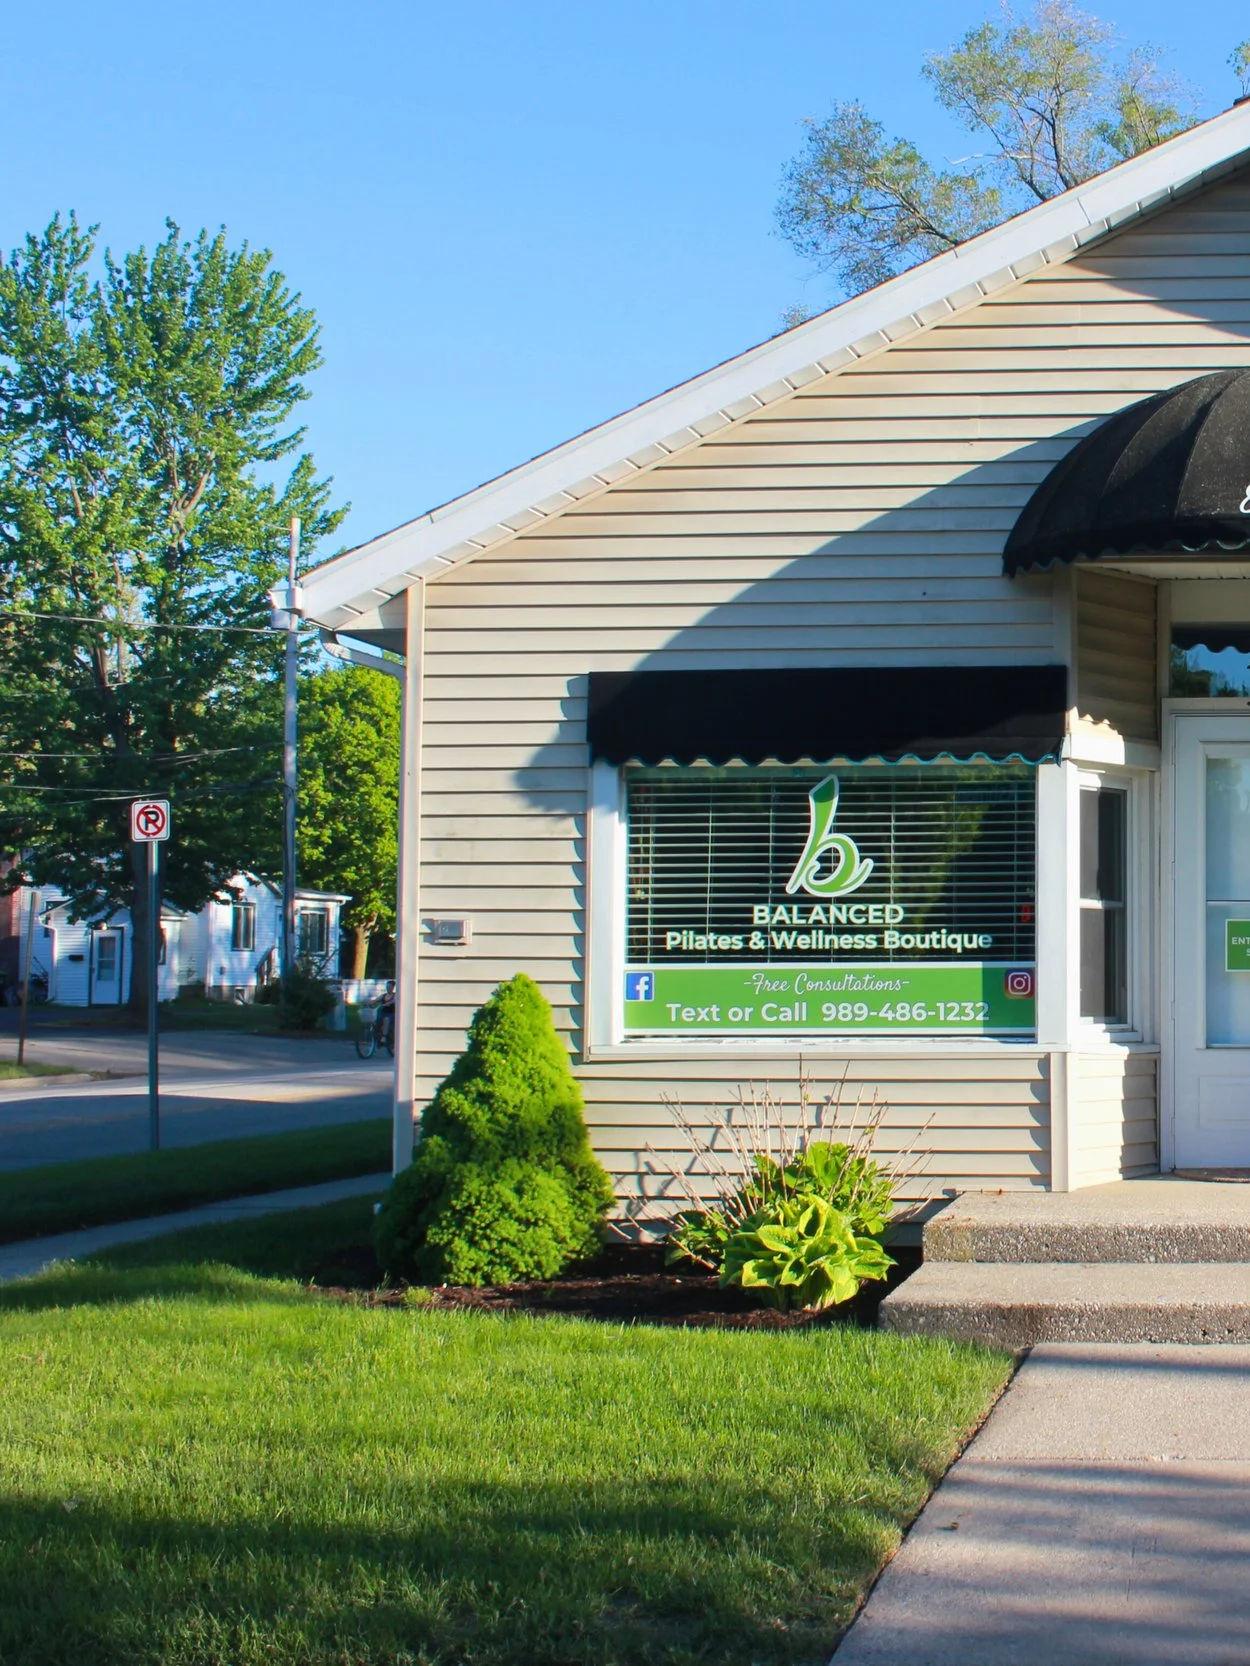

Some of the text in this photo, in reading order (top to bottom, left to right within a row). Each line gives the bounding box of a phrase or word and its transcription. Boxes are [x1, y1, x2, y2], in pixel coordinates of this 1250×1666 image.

[753, 904, 905, 925] BALANCED
[666, 928, 993, 954] Pilates & Wellness Boutique
[666, 1002, 990, 1022] Text or Call 989-486-1232
